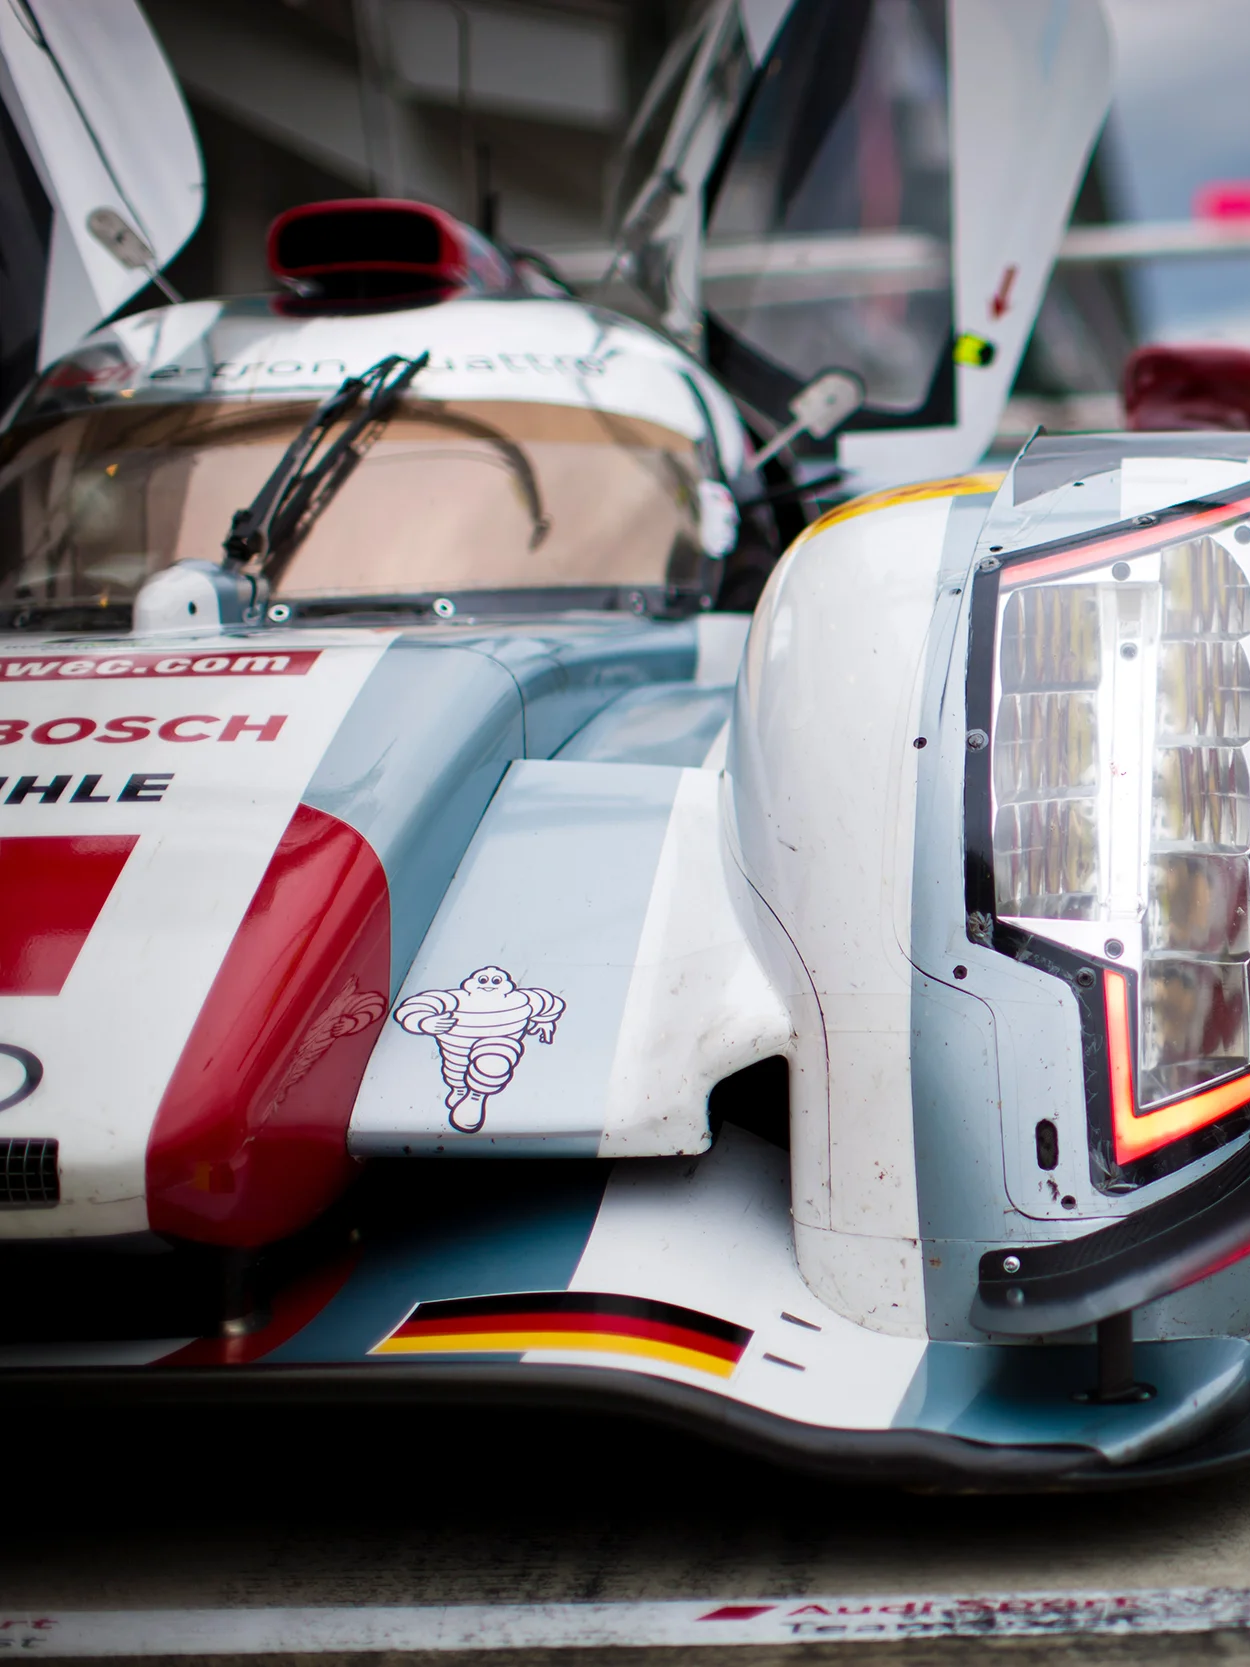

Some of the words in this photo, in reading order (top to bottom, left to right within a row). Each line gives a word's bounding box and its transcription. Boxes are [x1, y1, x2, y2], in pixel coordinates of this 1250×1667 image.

[420, 353, 606, 377] uattro
[0, 655, 291, 677] wec.com
[0, 772, 176, 805] HLE
